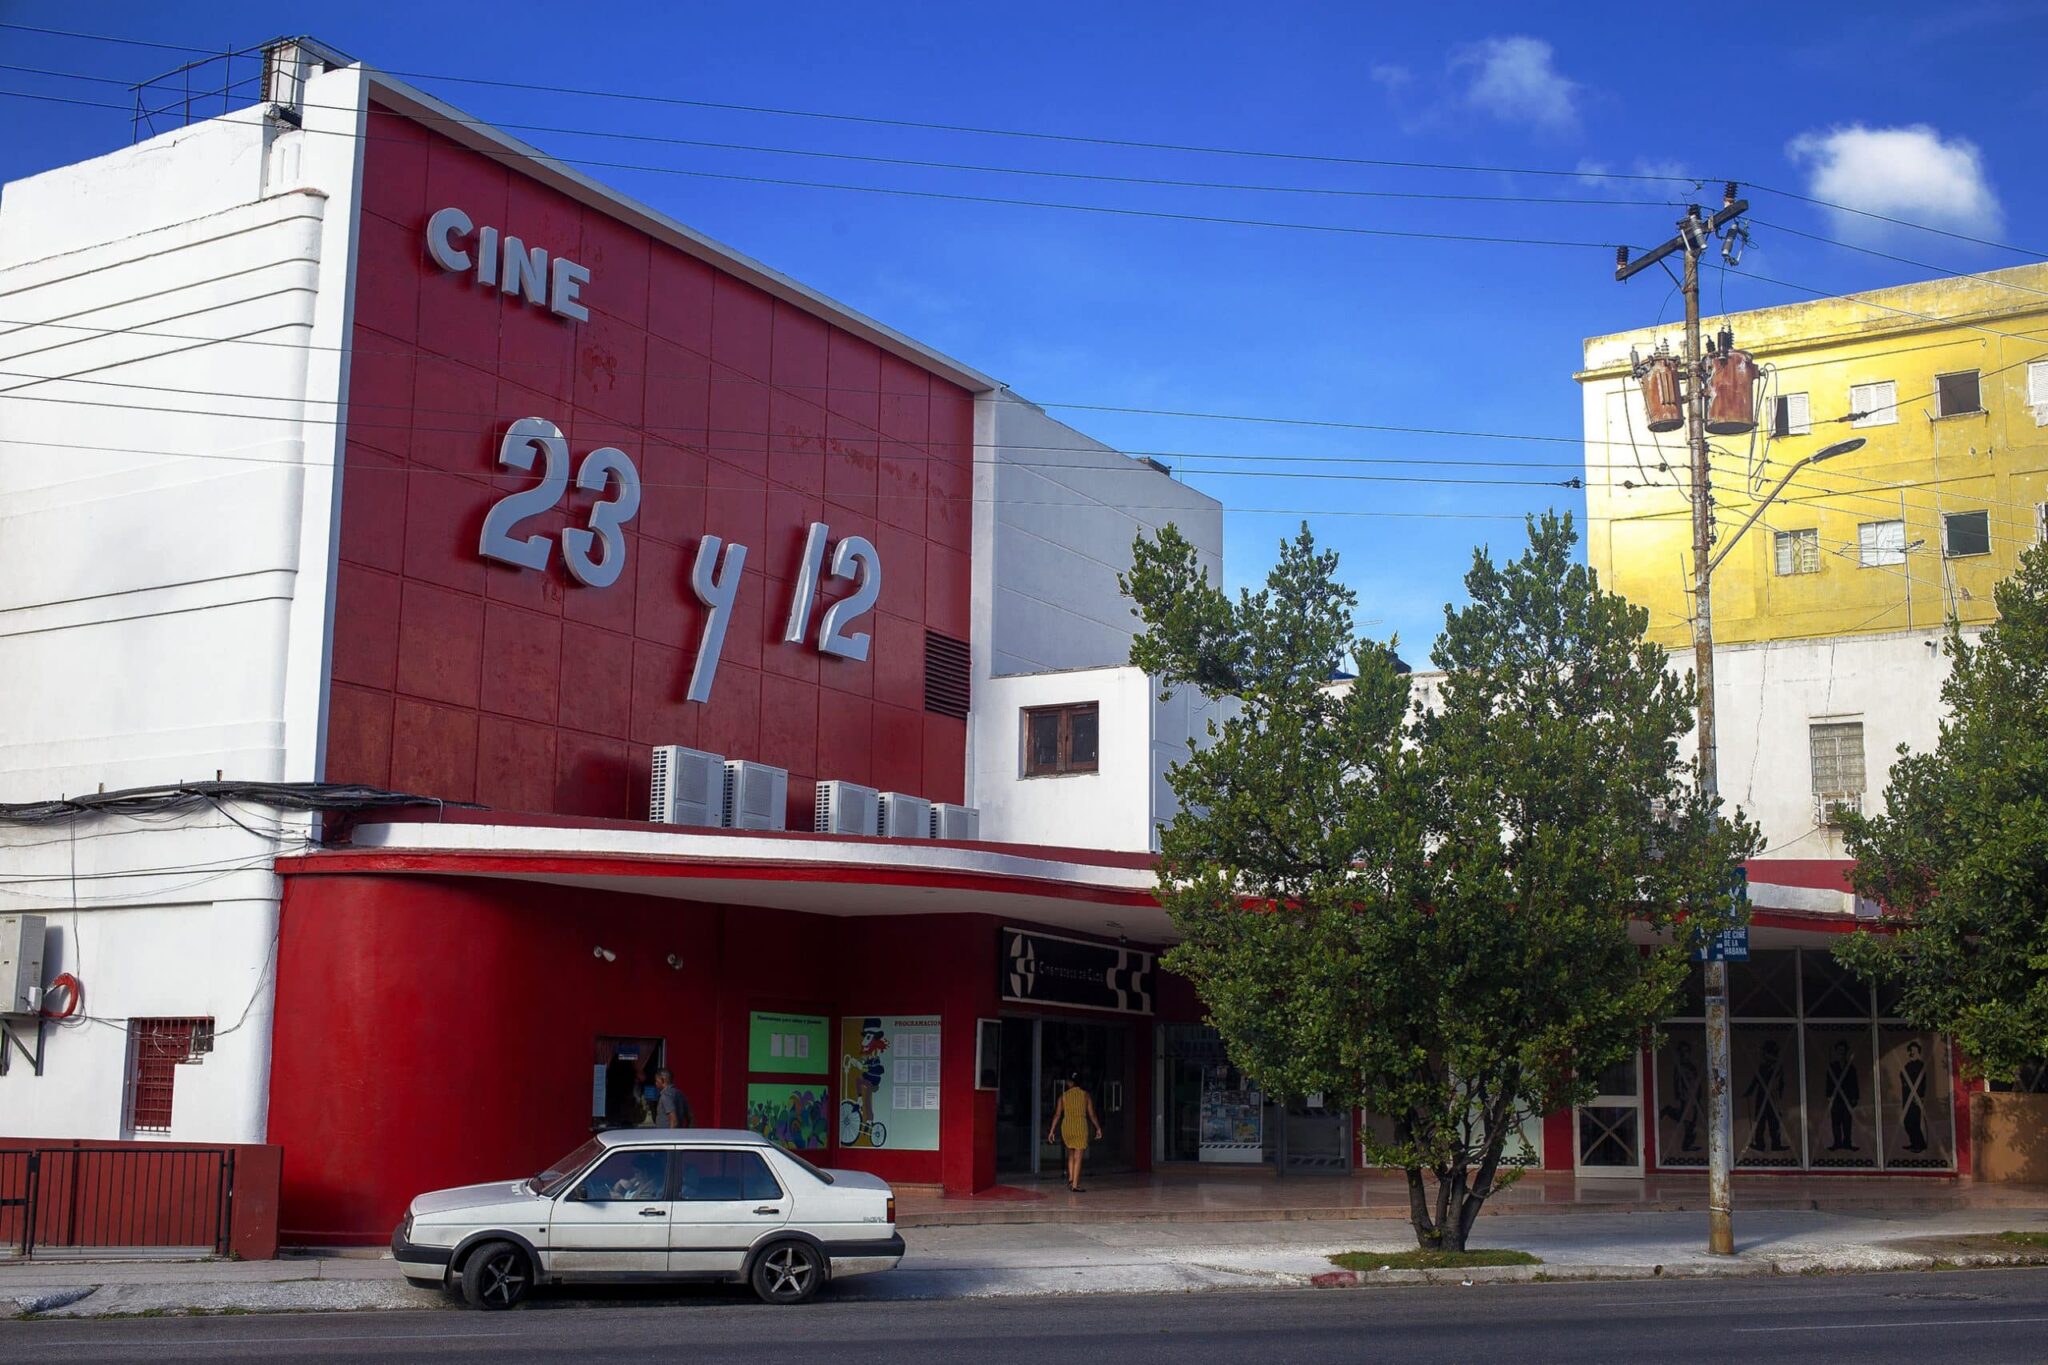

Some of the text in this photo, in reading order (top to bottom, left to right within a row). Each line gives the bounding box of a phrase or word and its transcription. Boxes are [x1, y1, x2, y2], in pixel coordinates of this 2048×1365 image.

[426, 207, 591, 323] CINE
[478, 416, 641, 588] 23
[784, 522, 881, 661] 12
[1724, 947, 1747, 955] HABANA
